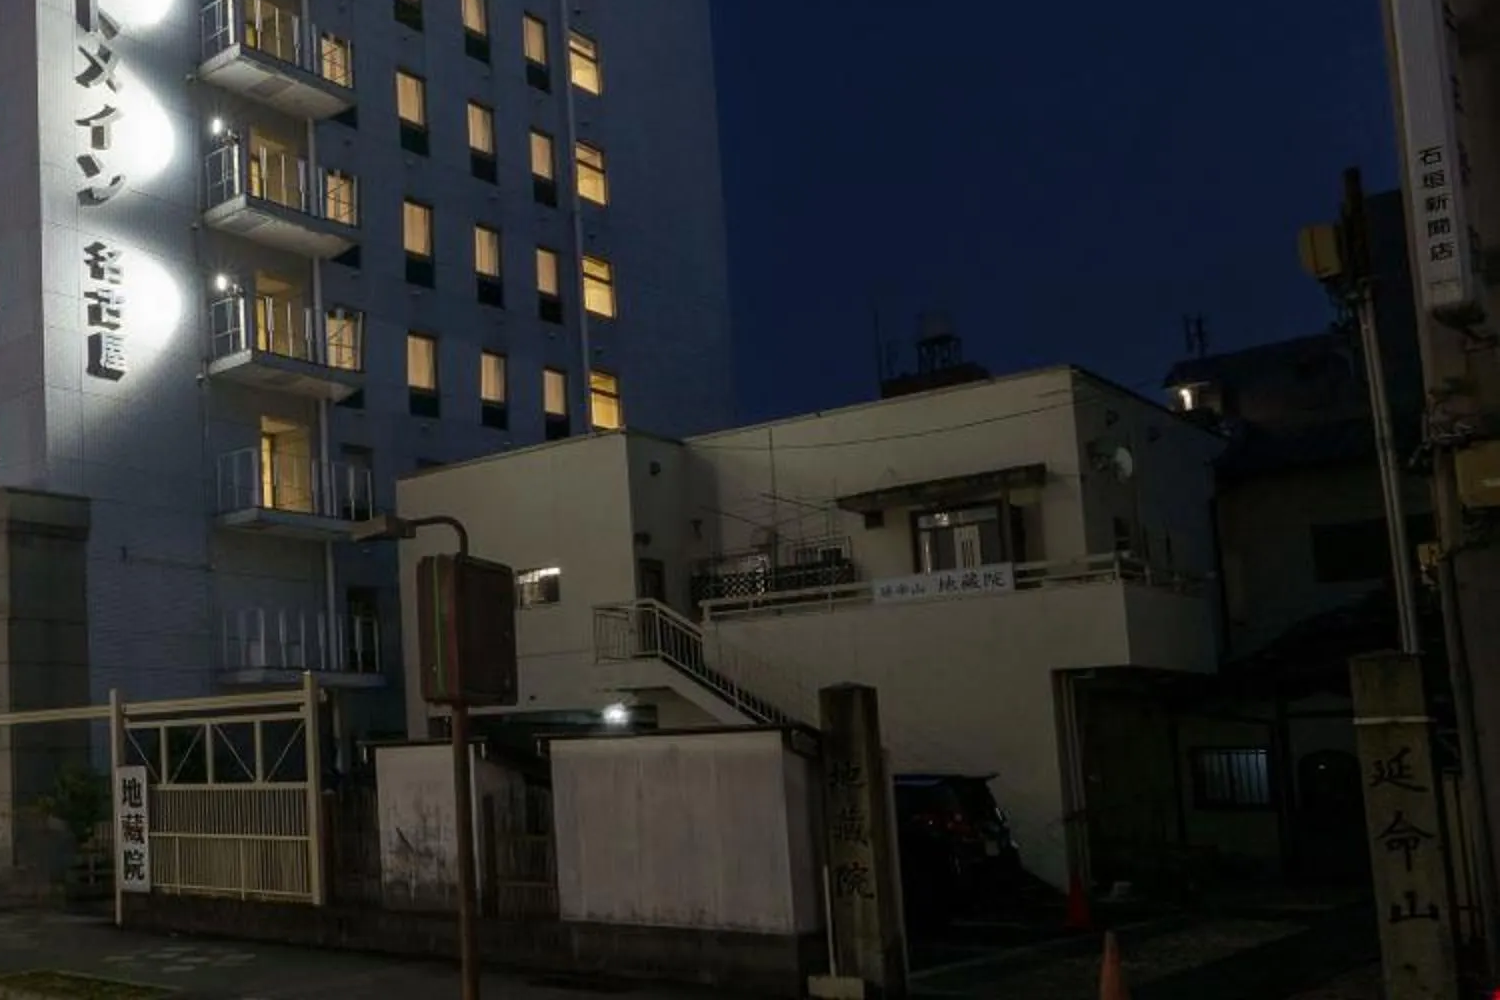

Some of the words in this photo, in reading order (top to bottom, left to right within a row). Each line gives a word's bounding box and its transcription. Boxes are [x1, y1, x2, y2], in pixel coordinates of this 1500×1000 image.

[83, 240, 127, 383] 名古屋
[1368, 746, 1440, 923] 延命山
